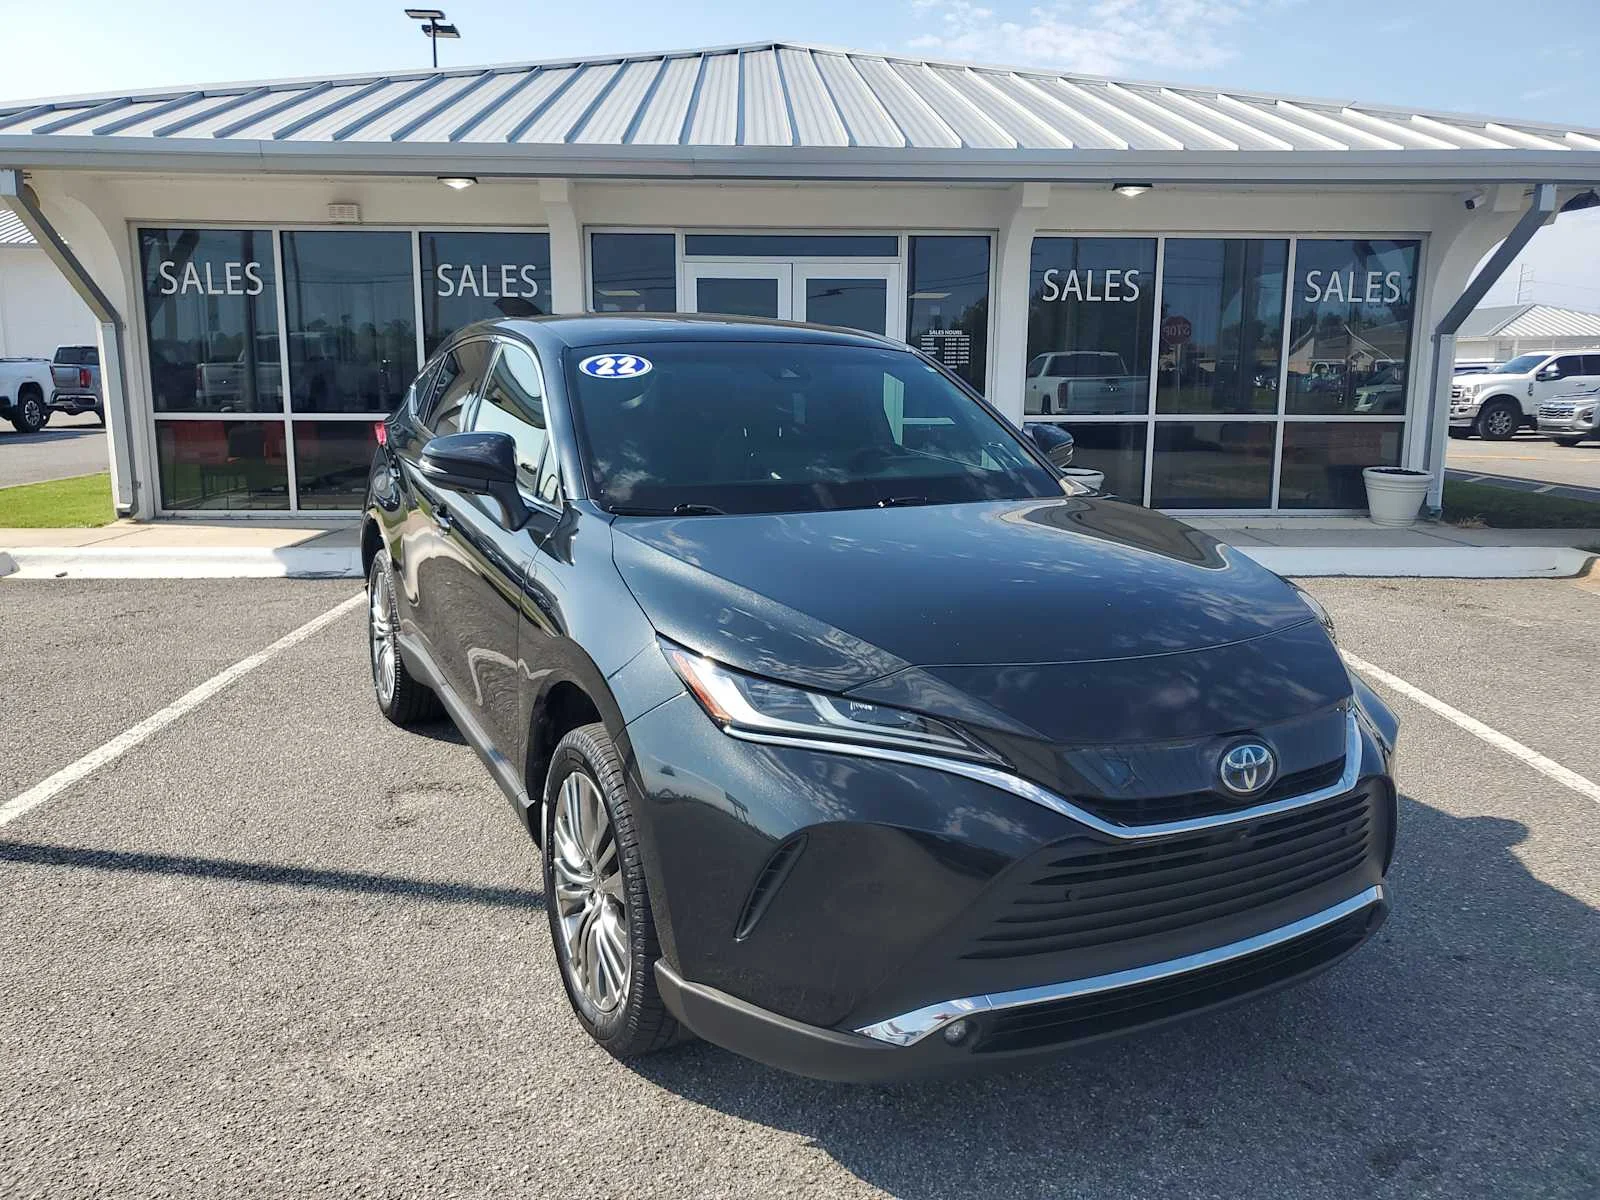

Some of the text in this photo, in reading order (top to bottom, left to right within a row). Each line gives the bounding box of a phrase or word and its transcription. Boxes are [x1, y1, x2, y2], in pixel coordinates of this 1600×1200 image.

[159, 261, 263, 295] SALES
[437, 264, 538, 297] SALES
[1042, 269, 1140, 302] SALES
[1304, 270, 1401, 303] SALES
[595, 357, 637, 375] 22
